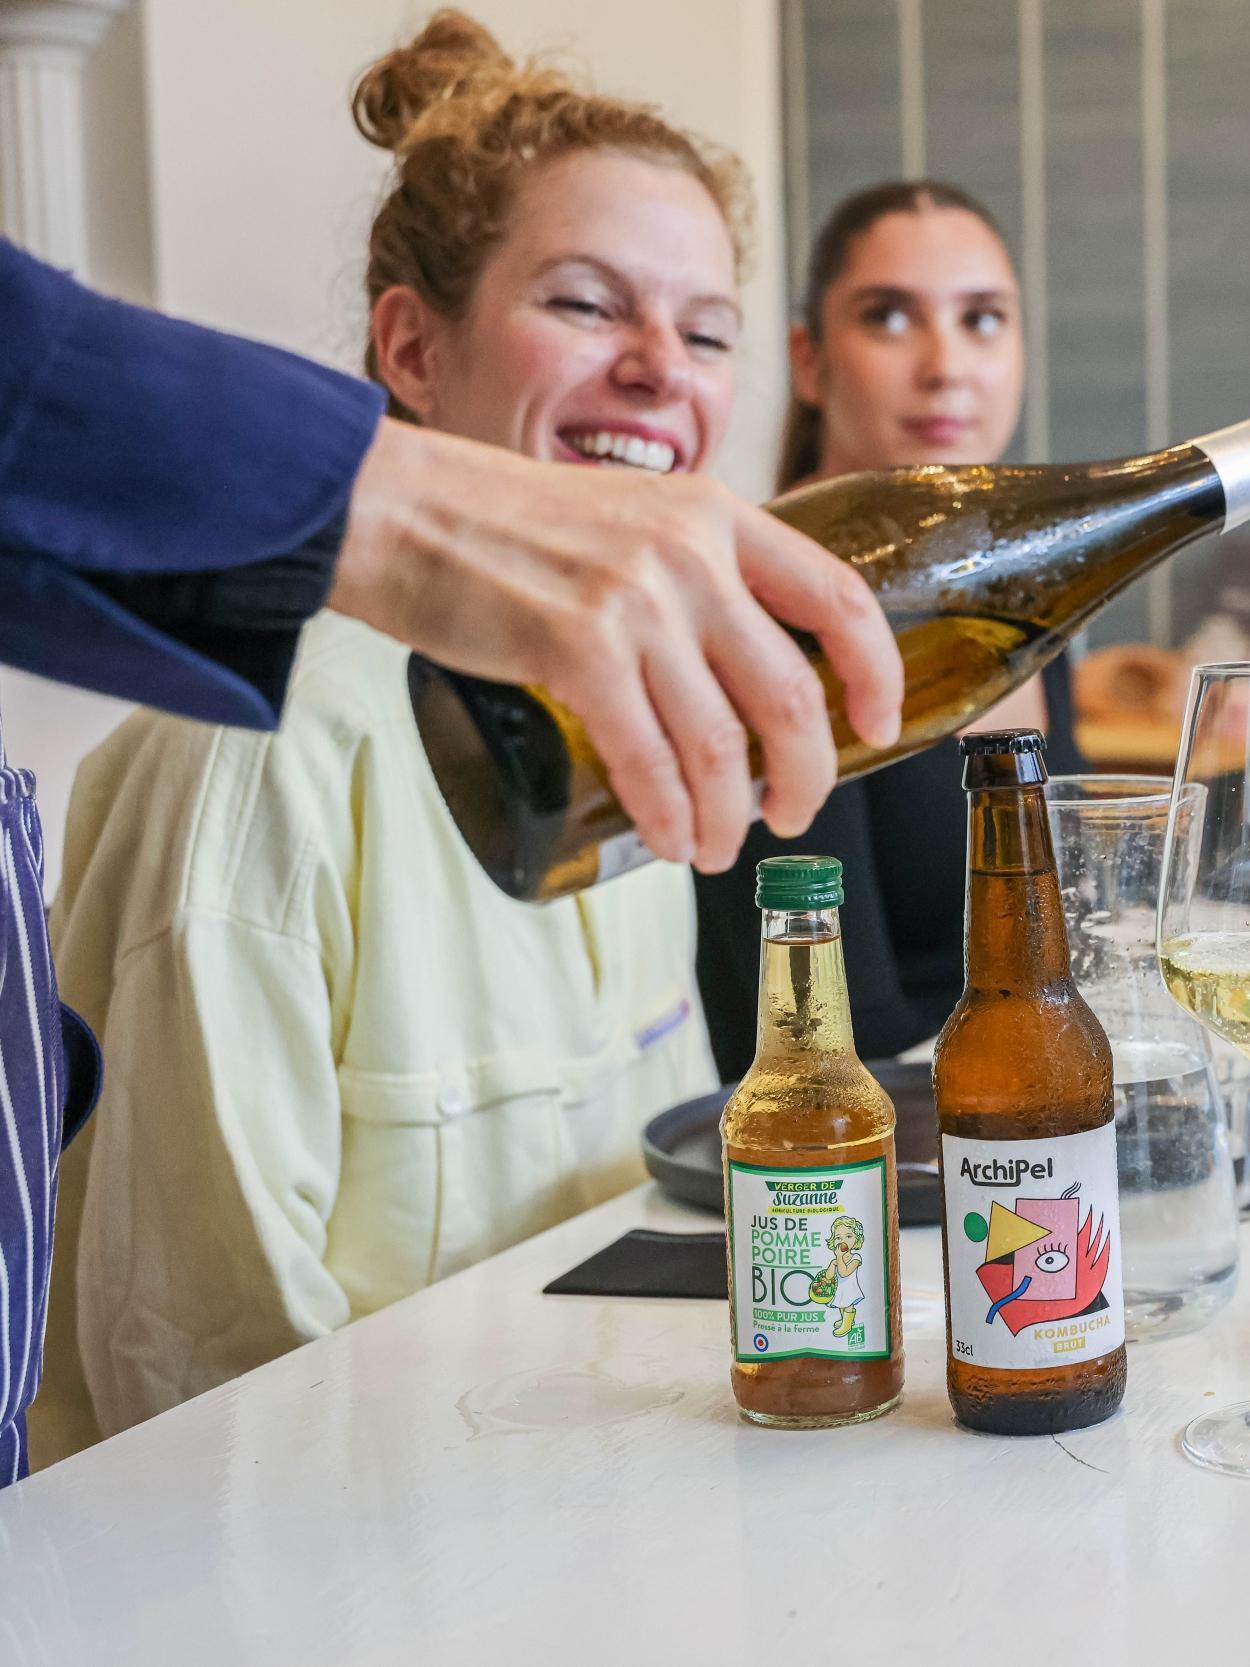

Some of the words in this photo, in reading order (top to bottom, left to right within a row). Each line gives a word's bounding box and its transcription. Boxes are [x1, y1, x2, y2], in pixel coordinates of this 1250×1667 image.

[774, 1182, 817, 1191] VERGER
[821, 1181, 836, 1190] DE
[773, 1192, 838, 1206] Suzanne
[751, 1215, 778, 1230] JUS
[785, 1218, 808, 1231] DE
[751, 1229, 821, 1248] POMME
[752, 1246, 811, 1265] POIRE
[752, 1266, 816, 1306] BIO
[754, 1309, 775, 1320] 100%
[777, 1311, 797, 1322] PUR
[800, 1312, 819, 1322] JUS
[1034, 1315, 1111, 1341] KOMBUCHA
[849, 1332, 863, 1344] AB
[1056, 1338, 1084, 1351] BRUT
[956, 1340, 974, 1356] 33cl
